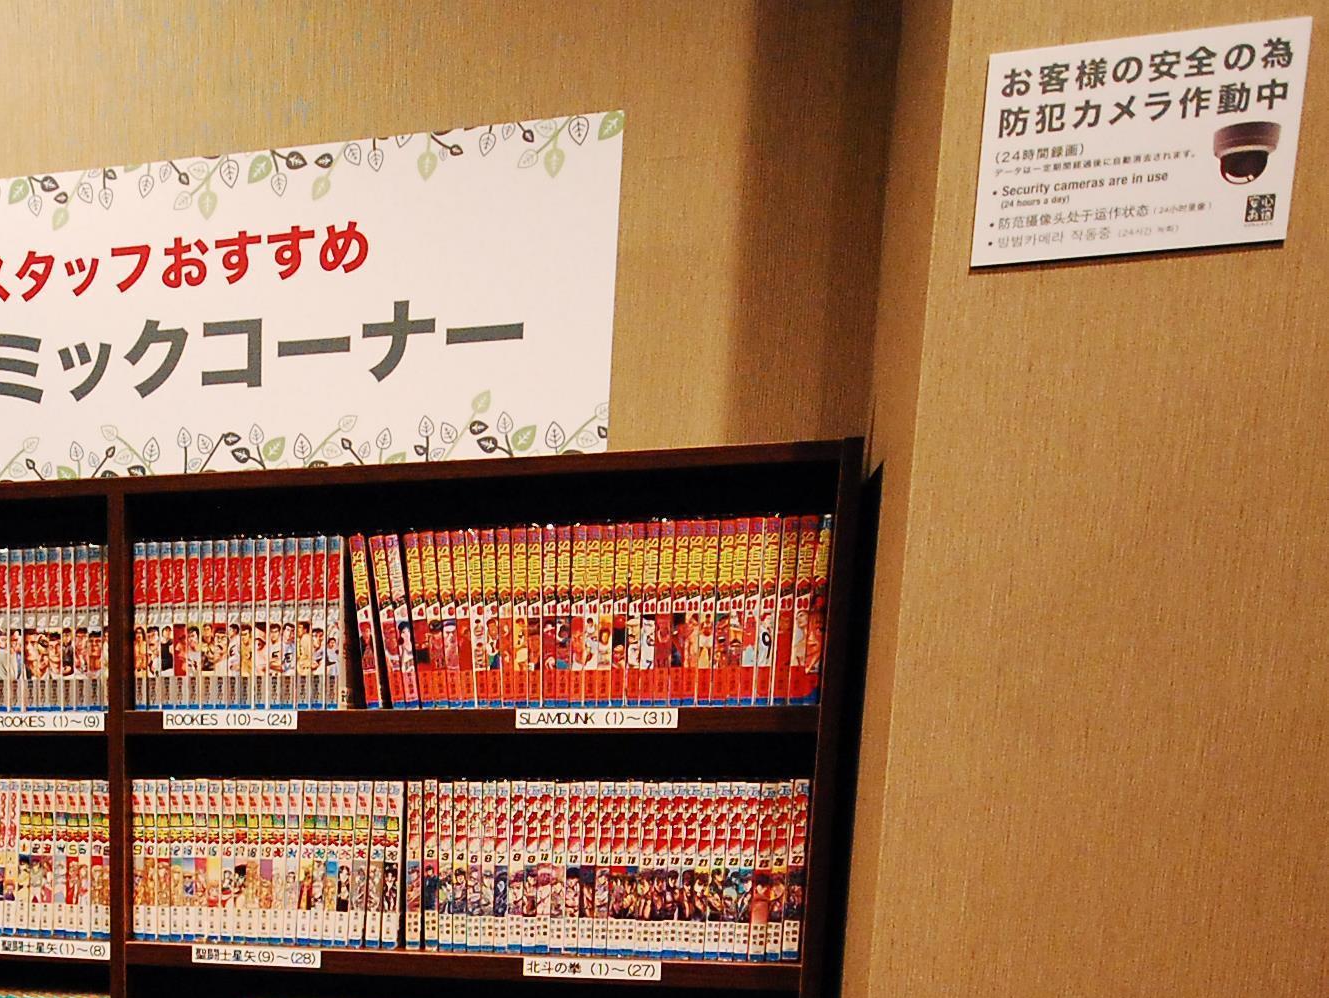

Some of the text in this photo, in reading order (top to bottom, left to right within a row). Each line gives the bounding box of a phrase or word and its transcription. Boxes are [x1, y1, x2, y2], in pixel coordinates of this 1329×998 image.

[1001, 37, 1294, 98] お客様の安全の為
[998, 78, 1289, 138] 防犯カメラ作動中
[1001, 171, 1169, 197] Security cameras are in use
[1016, 198, 1041, 208] hours
[519, 712, 595, 725] SLAMDUNK
